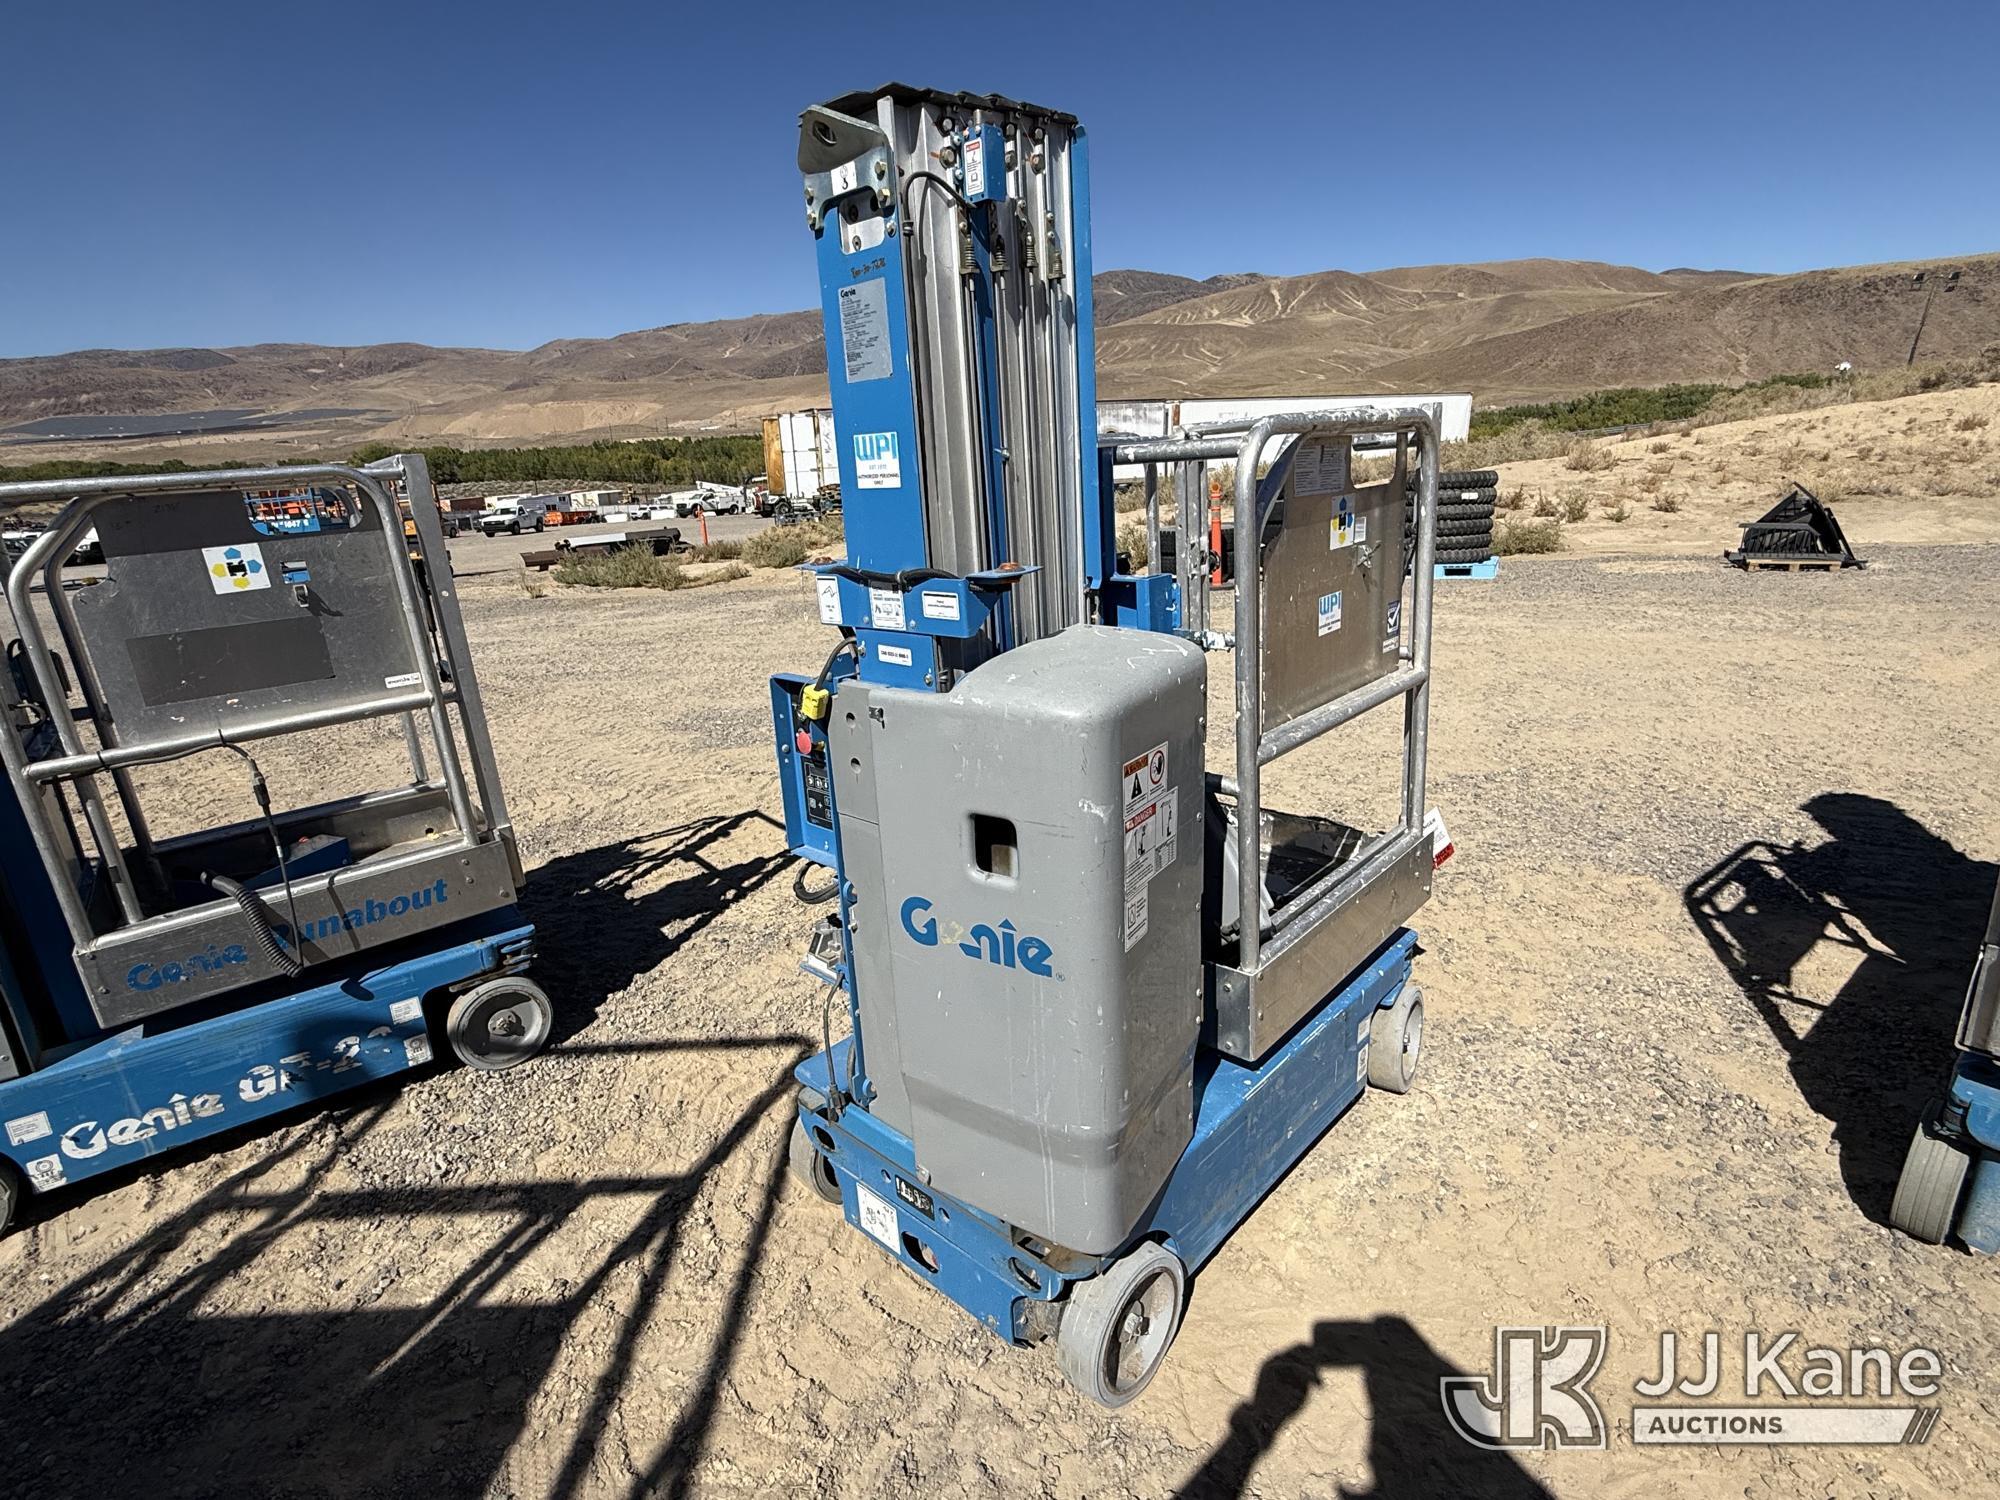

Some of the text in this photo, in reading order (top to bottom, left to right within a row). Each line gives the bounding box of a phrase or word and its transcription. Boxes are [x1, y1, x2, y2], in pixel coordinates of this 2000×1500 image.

[840, 288, 857, 298] Genie
[854, 433, 898, 461] WPI
[1319, 591, 1342, 615] WPI
[900, 896, 1053, 978] Gnie
[126, 943, 249, 992] Genie
[60, 1092, 225, 1160] Genie
